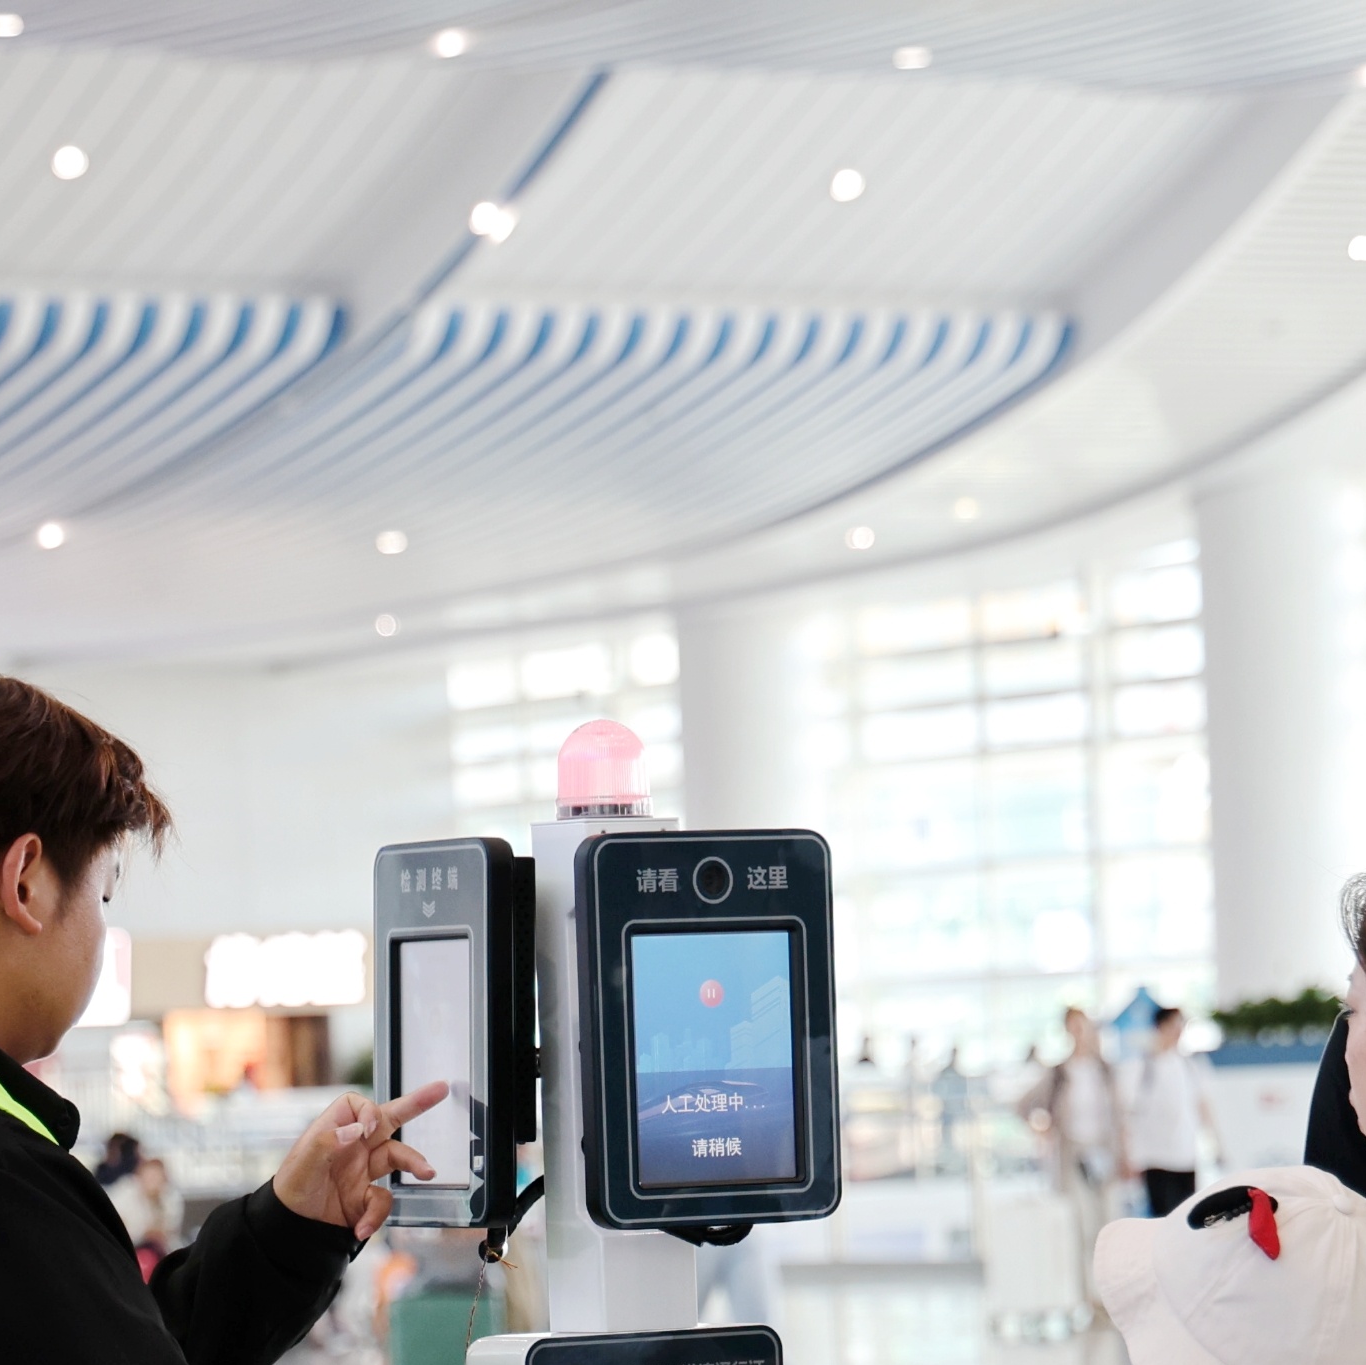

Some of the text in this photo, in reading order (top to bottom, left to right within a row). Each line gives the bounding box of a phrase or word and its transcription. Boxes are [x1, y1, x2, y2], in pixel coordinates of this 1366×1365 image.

[400, 865, 459, 894] 检测终端
[636, 865, 789, 893] 请看 这里
[691, 1137, 743, 1158] 请稍候
